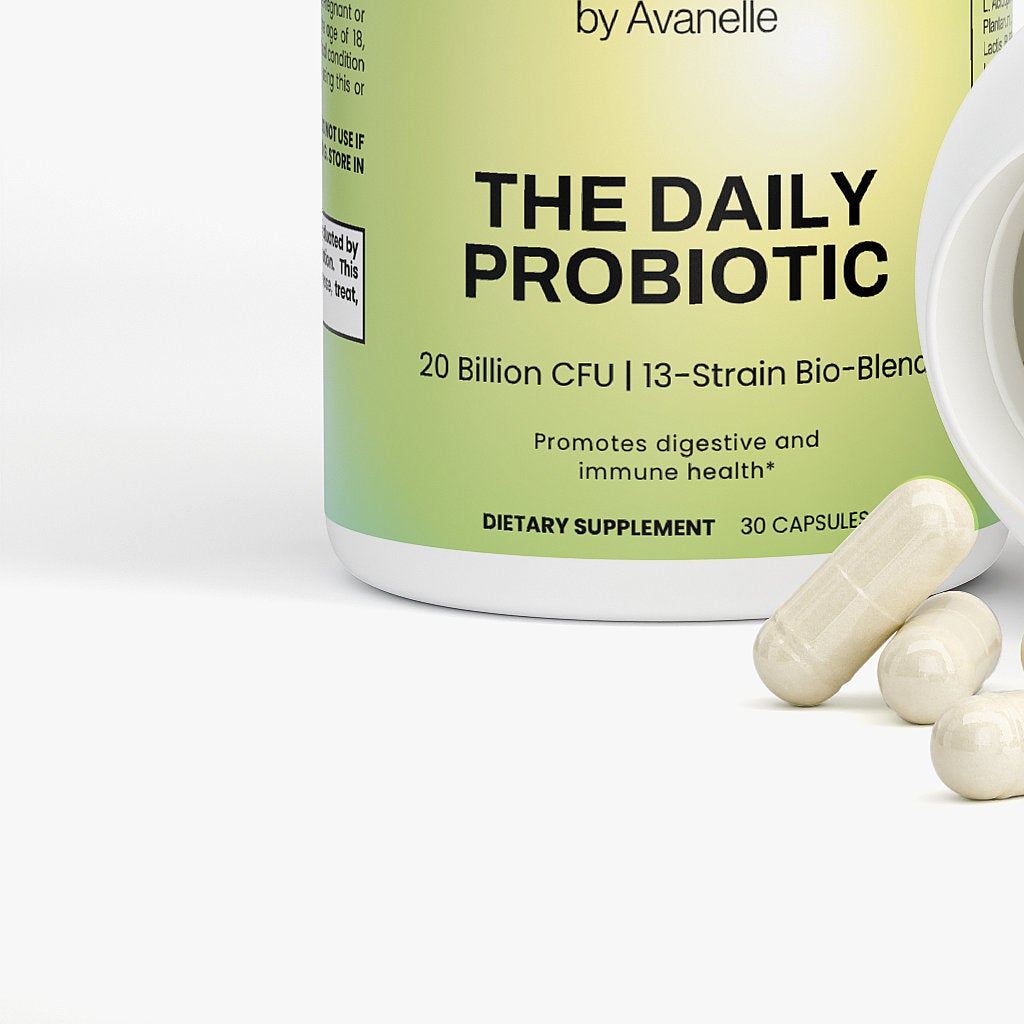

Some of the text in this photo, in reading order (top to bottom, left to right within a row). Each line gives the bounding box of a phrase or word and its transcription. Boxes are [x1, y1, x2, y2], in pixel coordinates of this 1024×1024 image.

[354, 9, 365, 23] or
[576, 0, 778, 42] by Avanelle
[340, 27, 349, 44] of
[352, 29, 365, 51] 18,
[328, 49, 365, 72] condition
[336, 73, 350, 93] this
[354, 81, 365, 96] or
[338, 127, 353, 148] USE
[355, 132, 365, 150] IF
[328, 147, 351, 172] STORE
[353, 156, 364, 174] IN
[475, 169, 878, 232] THE DAILY
[345, 236, 359, 260] by
[339, 258, 359, 280] This
[465, 240, 888, 305] PROBIOTIC
[334, 280, 359, 306] treat,
[420, 351, 449, 378] 20
[459, 356, 541, 385] Billion
[552, 362, 614, 387] CFU
[643, 360, 786, 388] 13-Strain
[534, 430, 820, 457] Promotes digestive and
[578, 462, 679, 481] immune
[482, 513, 568, 534] DIETARY
[574, 517, 715, 536] SUPPLEMENT
[741, 517, 765, 534] 30
